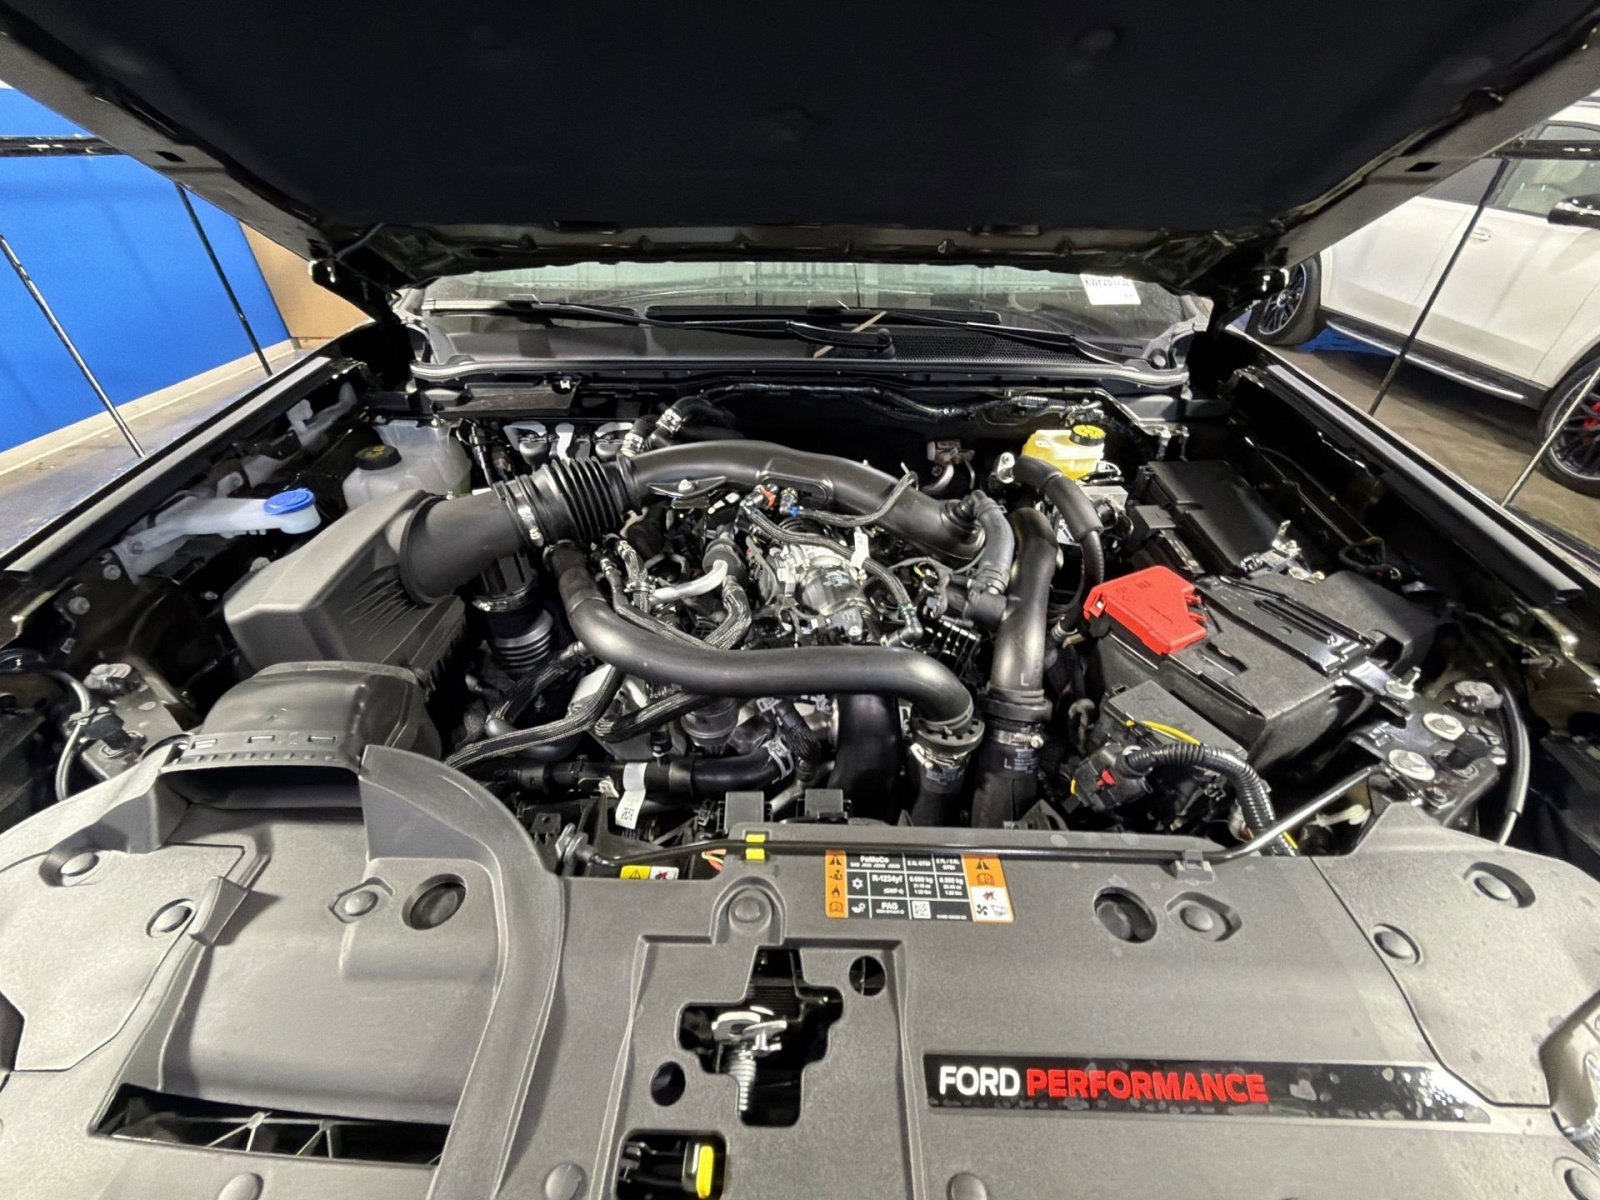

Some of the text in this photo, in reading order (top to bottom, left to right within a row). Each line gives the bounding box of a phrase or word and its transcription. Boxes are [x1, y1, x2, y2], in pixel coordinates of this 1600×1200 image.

[1020, 672, 1030, 686] L
[881, 901, 898, 910] PAG
[939, 1066, 1269, 1104] FORD PERFORMANCE
